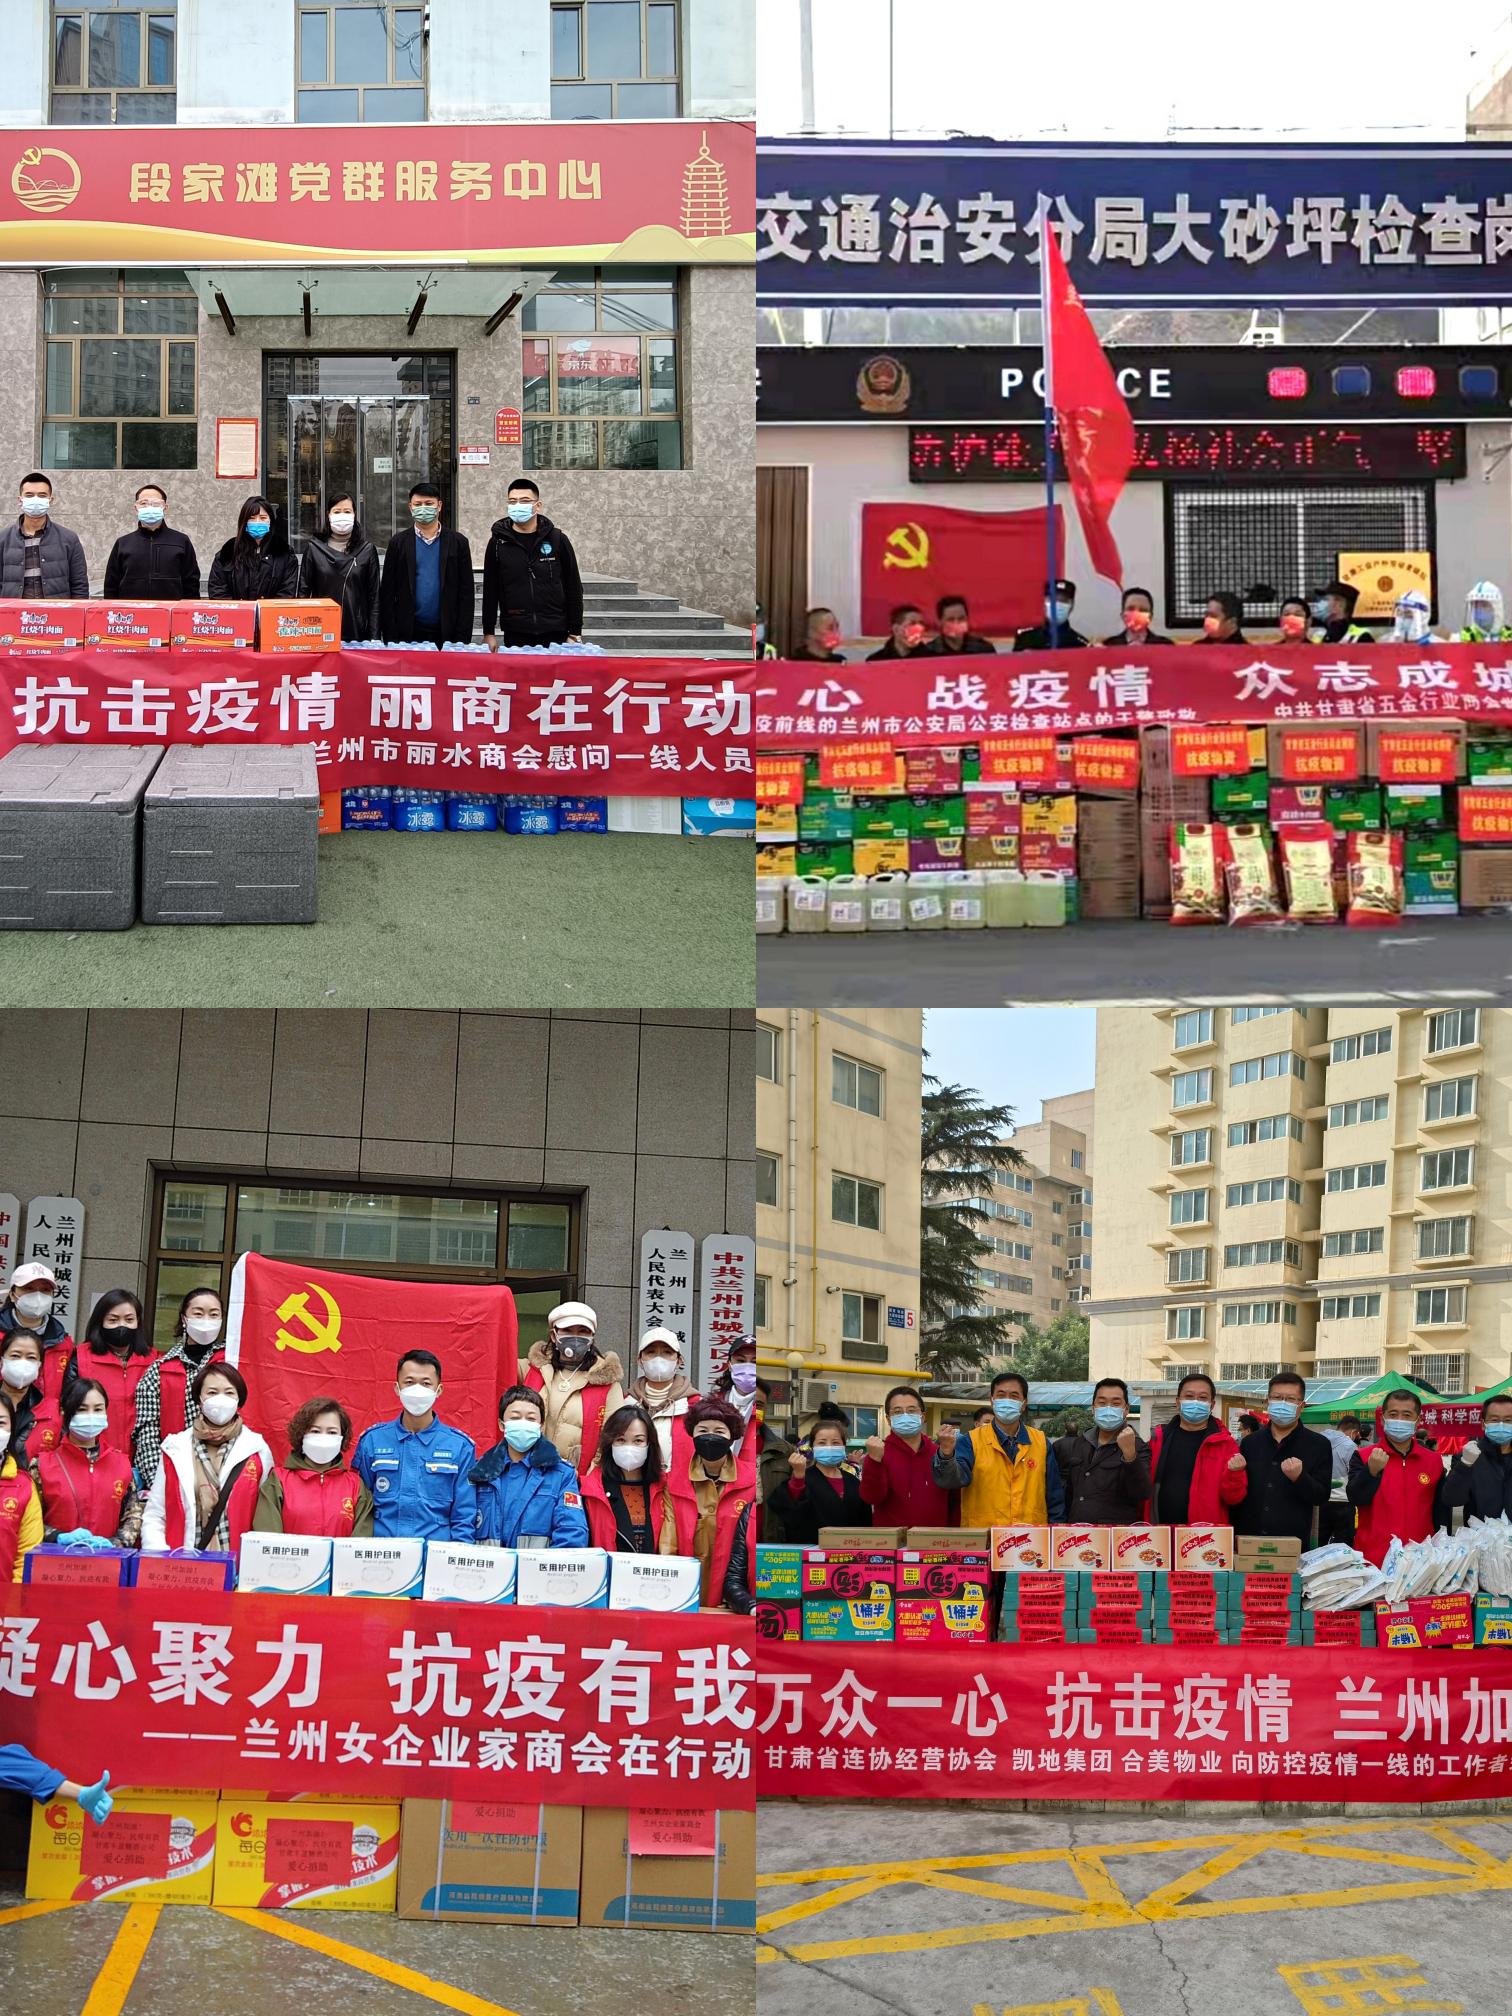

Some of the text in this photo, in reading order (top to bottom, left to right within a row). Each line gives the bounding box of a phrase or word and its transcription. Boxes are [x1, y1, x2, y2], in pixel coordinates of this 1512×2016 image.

[129, 159, 602, 203] 段家滩党群服务中心
[756, 192, 1512, 267] 交通治安分局大砂坪检查岗
[1001, 368, 1171, 398] PCE
[21, 625, 64, 635] 红烧牛肉面
[107, 625, 149, 635] 红烧牛肉面
[927, 665, 1153, 711] 战疫情
[1234, 659, 1512, 700] 众志成城
[14, 671, 753, 738] 抗击疫情 丽商在行动
[312, 739, 754, 775] 兰州市丽水商会慰问一线人员
[1187, 752, 1237, 767] 抗疫物资
[1296, 757, 1345, 772] 抗疫物资
[832, 761, 883, 778] 抗疫物资
[994, 757, 1044, 773] 抗疫物资
[1076, 763, 1125, 779] 抗疫物资
[1392, 757, 1443, 773] 抗疫物资
[407, 811, 434, 827] 冰露
[458, 811, 485, 826] 冰露
[521, 815, 548, 830] 冰露
[48, 1215, 75, 1317] 兰州市城关区
[645, 1248, 666, 1328] 人民代表大会
[668, 1248, 688, 1345] 兰州市城
[906, 1312, 914, 1327] 5
[262, 1545, 310, 1557] 医用护目镜
[354, 1549, 402, 1560] 医用护目镜
[447, 1556, 495, 1569] 医用护目镜
[539, 1562, 586, 1574] 医用护目镜
[632, 1566, 679, 1578] 医用护目镜
[853, 1603, 885, 1618] 1桶半
[945, 1604, 979, 1621] 1桶半
[1391, 1633, 1417, 1646] 1桶半
[387, 1631, 756, 1730] 抗疫有我
[756, 1669, 1512, 1745] 万众一心 抗击疫情 兰州加
[765, 1746, 997, 1773] 甘肃省连协经营协会
[1012, 1747, 1112, 1774] 凯地集团
[1121, 1748, 1224, 1775] 合美物业
[474, 1806, 516, 1818] 爱心捐助
[652, 1832, 693, 1844] 爱心捐助
[103, 1854, 145, 1866] 爱心捐助
[288, 1860, 329, 1873] 爱心捐助
